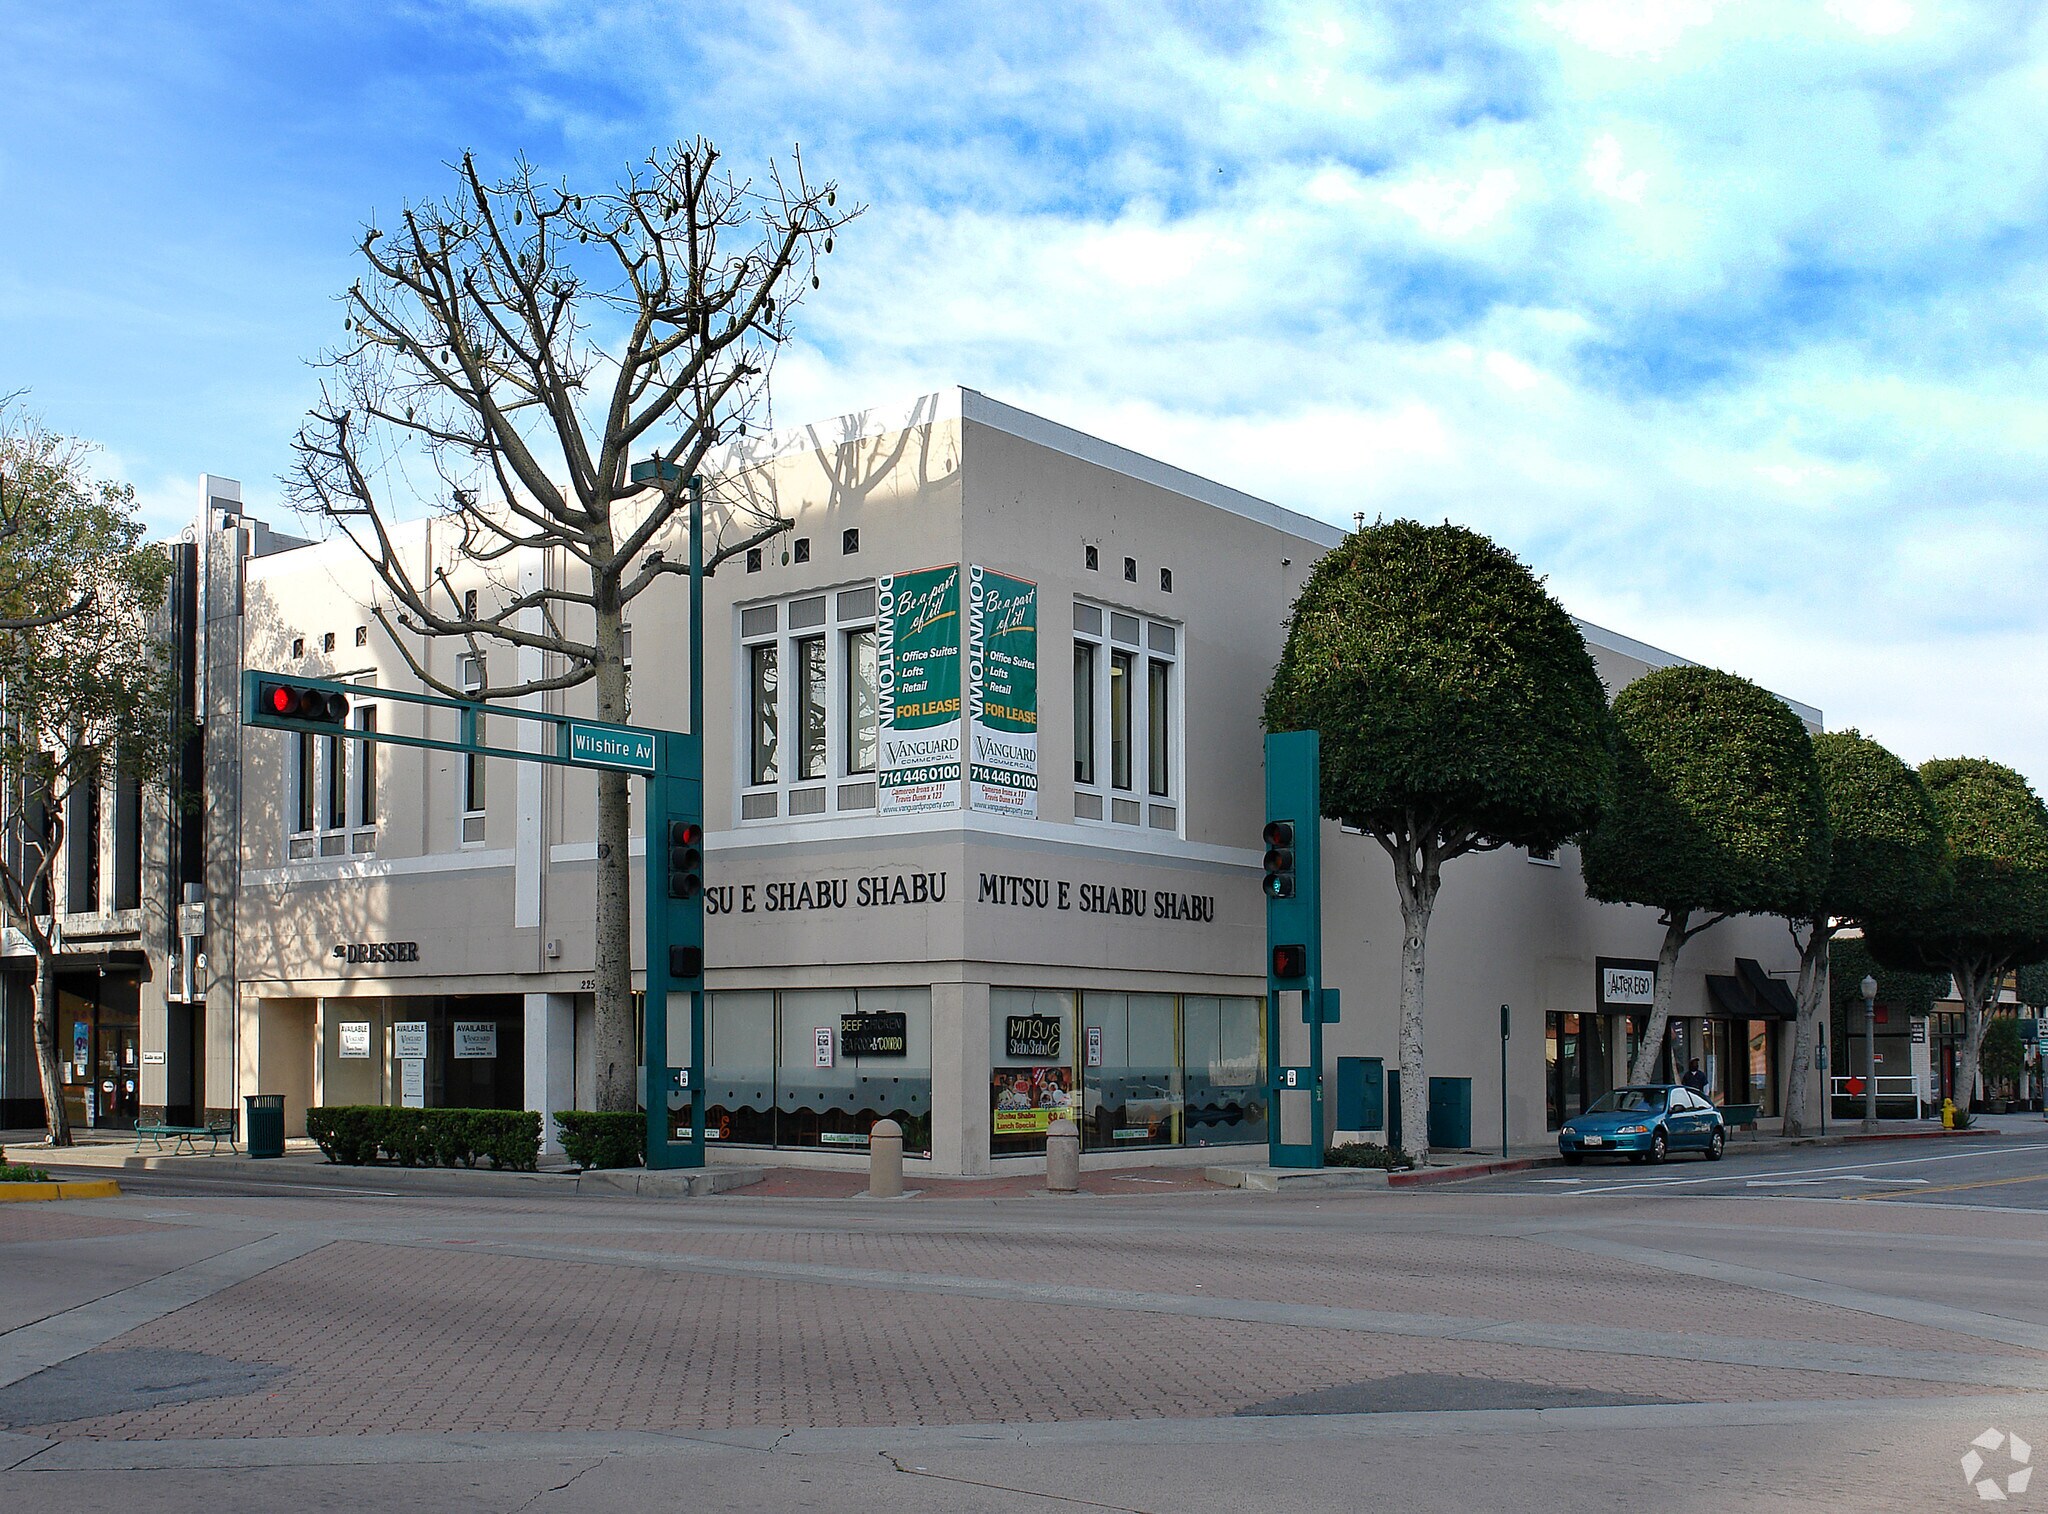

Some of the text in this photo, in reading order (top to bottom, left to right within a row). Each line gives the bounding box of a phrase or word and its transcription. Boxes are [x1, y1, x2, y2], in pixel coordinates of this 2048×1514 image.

[897, 569, 958, 617] Be a part
[986, 588, 1035, 613] Be a part
[910, 602, 927, 633] of
[996, 608, 1012, 636] of
[879, 574, 894, 729] DOWNTOWN
[902, 646, 958, 662] Office Suites
[970, 564, 984, 723] DOWNTOWN
[990, 651, 1035, 670] Office Suites
[902, 667, 924, 678] Lofts
[990, 666, 1008, 679] Lofts
[902, 680, 928, 693] Retail
[990, 682, 1012, 695] Retail
[896, 698, 960, 719] FOR LEASE
[985, 702, 1037, 724] FOR LEASE
[576, 735, 651, 759] Wilshire Av
[884, 738, 959, 765] VANGUARD
[977, 735, 1037, 762] VANGUARD
[901, 754, 955, 765] COMMERCIAL
[988, 758, 1033, 770] COMMERCIAL
[880, 765, 960, 786] 714 446 0100
[971, 767, 1037, 789] 714 446 0100
[704, 871, 947, 915] SU E SHABU SHABU
[978, 872, 1214, 922] MITSU E SHABU SHABU
[346, 942, 420, 964] DRESSER
[341, 1025, 367, 1033] AVAILABLE
[396, 1025, 425, 1033] AVAILABLE
[841, 1019, 862, 1031] BEEF
[1011, 1019, 1049, 1039] MITSU
[997, 1122, 1014, 1130] Lunch
